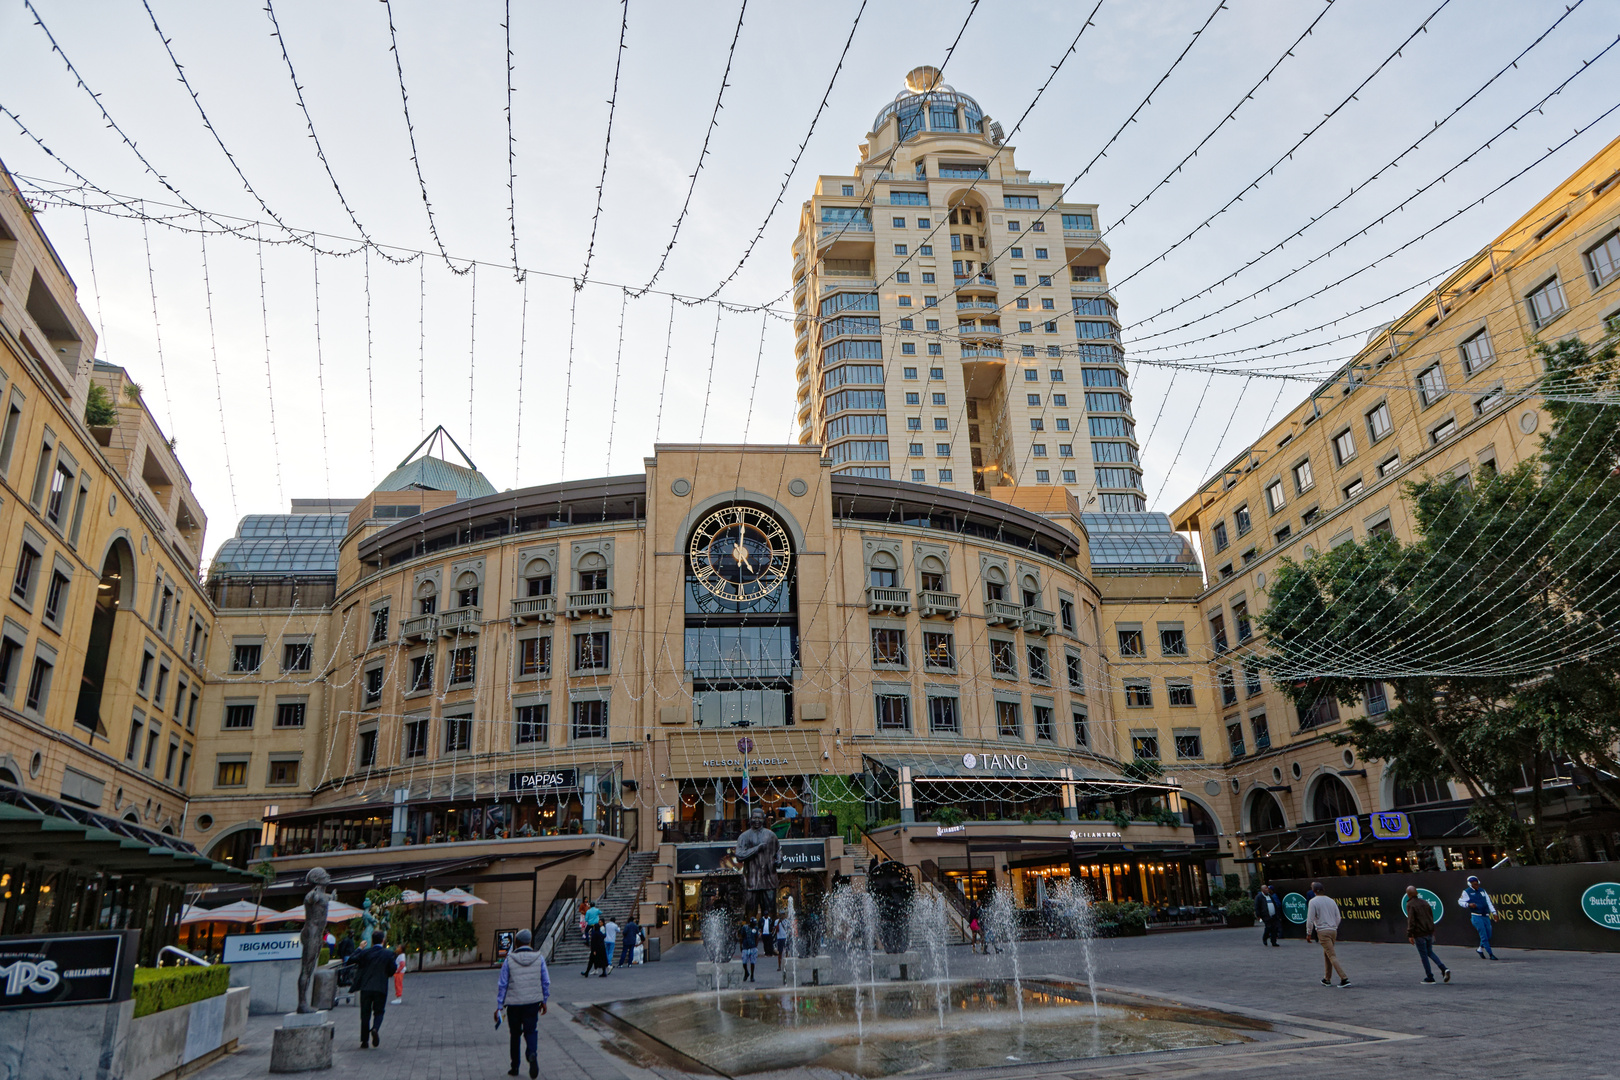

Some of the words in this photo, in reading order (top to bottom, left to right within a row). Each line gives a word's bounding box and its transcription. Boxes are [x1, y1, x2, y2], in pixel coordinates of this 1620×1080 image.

[703, 759, 740, 767] NELSON
[979, 753, 1028, 770] TANG
[521, 773, 564, 786] PAPPAS
[788, 853, 808, 862] with
[1344, 898, 1355, 907] US,
[1356, 897, 1380, 906] WE'RE
[1500, 893, 1525, 905] LOOK
[1589, 895, 1618, 906] Butcher
[1347, 910, 1381, 920] GRILLING
[1517, 909, 1550, 921] SOON
[63, 967, 111, 978] GRILLHOUSE
